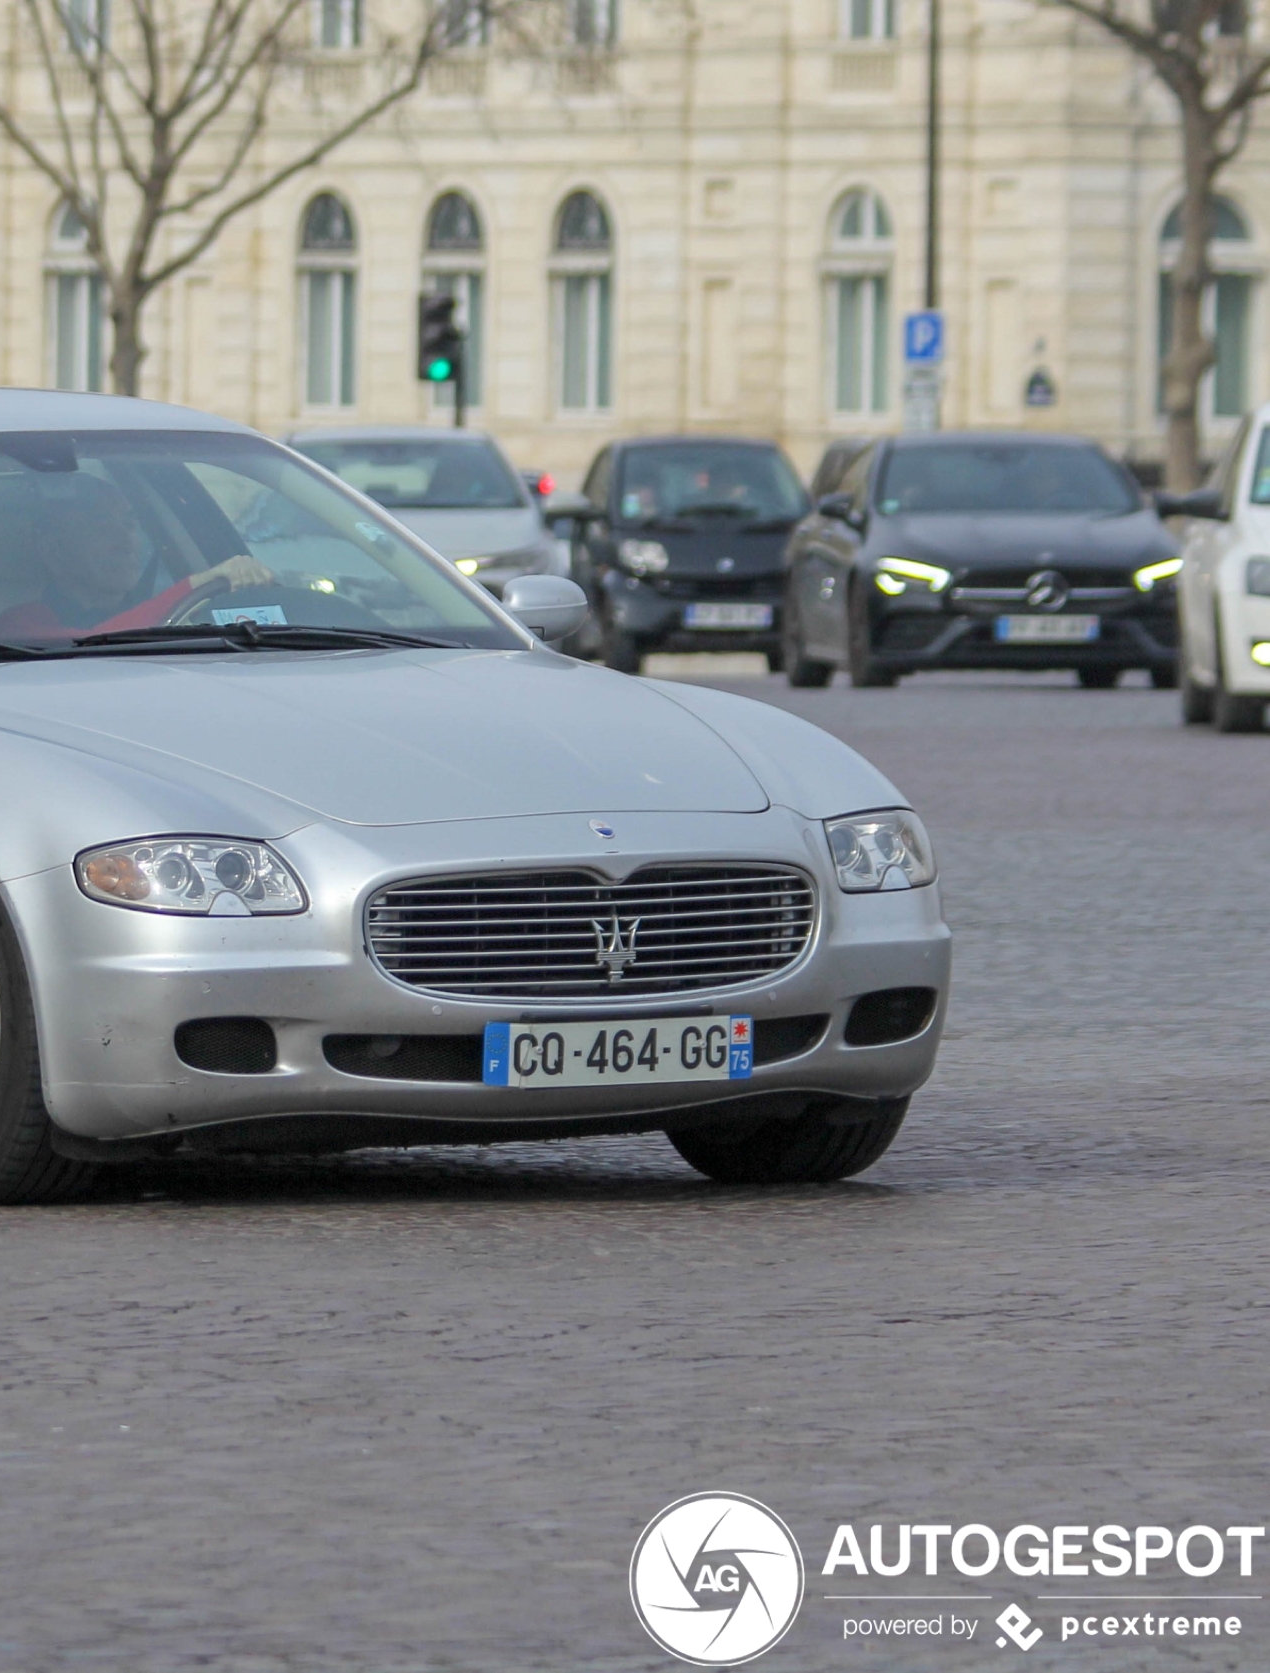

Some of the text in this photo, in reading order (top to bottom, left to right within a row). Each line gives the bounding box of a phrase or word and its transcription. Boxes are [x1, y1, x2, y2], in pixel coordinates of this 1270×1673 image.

[912, 320, 935, 353] P
[489, 1060, 500, 1073] F
[732, 1050, 749, 1071] 75
